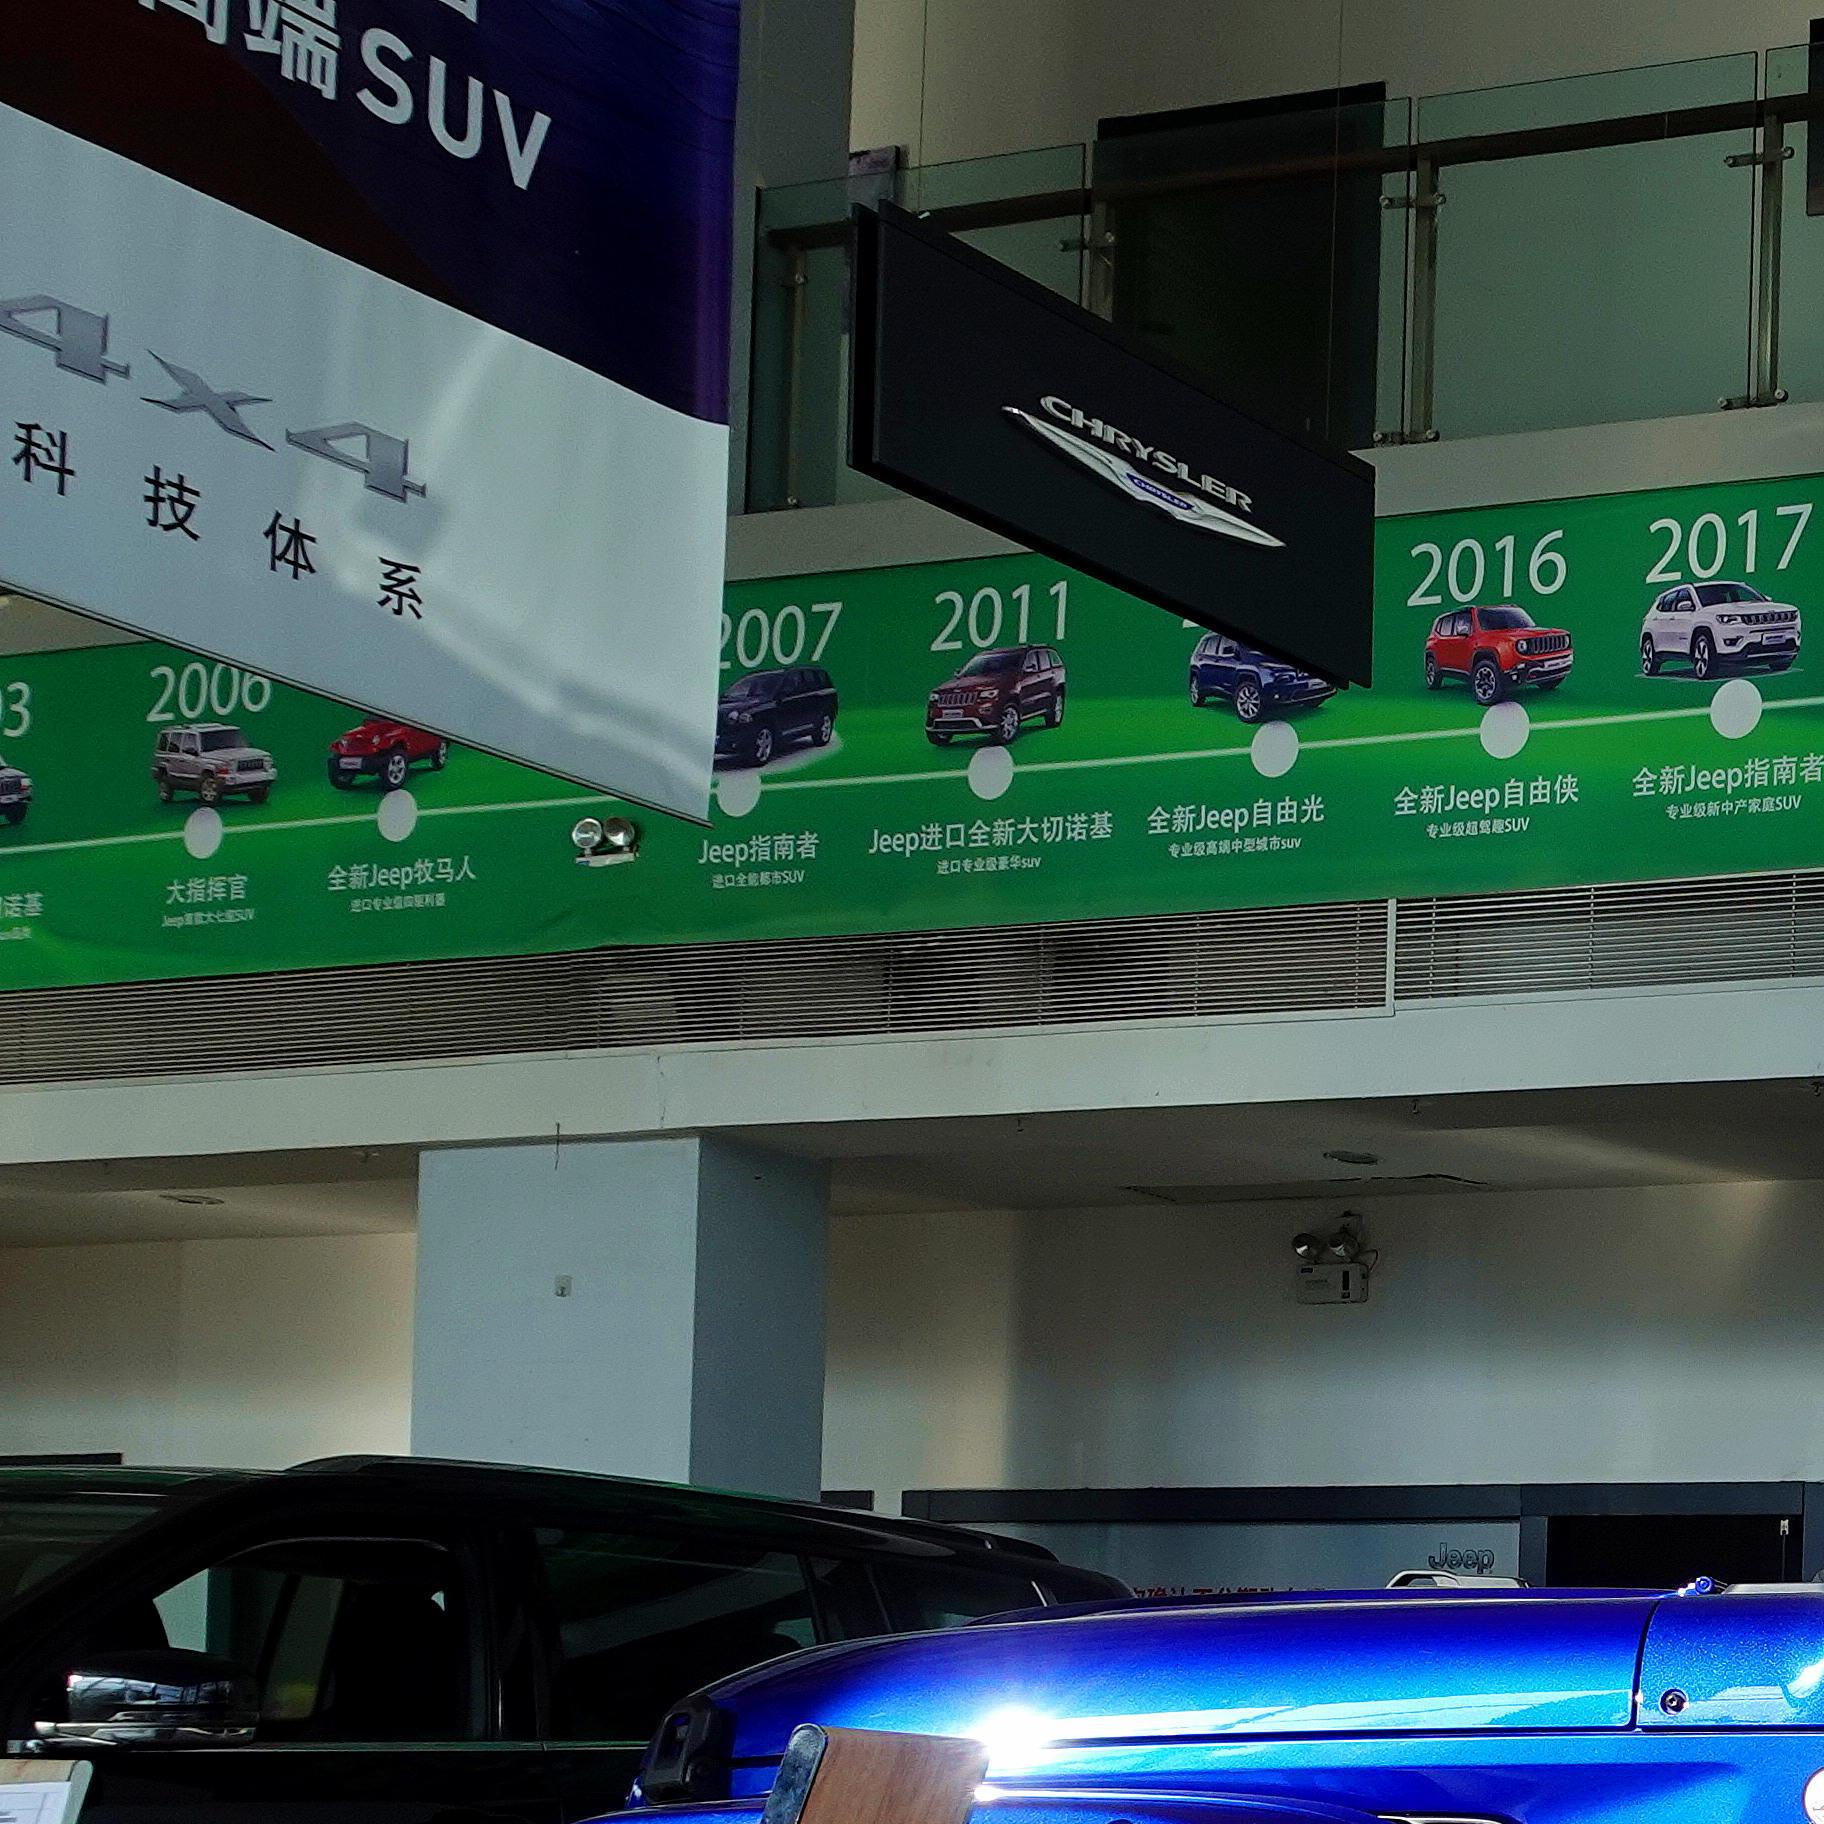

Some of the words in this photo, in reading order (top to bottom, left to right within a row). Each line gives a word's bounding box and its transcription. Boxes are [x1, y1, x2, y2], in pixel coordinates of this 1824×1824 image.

[1040, 395, 1254, 513] CHRYSLER
[12, 420, 425, 620] 科技体系
[1645, 502, 1813, 585] 2017
[1406, 529, 1567, 607] 2016
[929, 580, 1069, 652] 2011
[1146, 793, 1325, 835] 全新Jeep自由光
[1393, 773, 1580, 817] 全新Jeep自由侠
[1665, 795, 1802, 821] 专业级新中产家庭SUV
[697, 830, 820, 868] Jeep指南者
[868, 810, 1113, 858] Jeep进口全新大切诺基
[165, 872, 250, 905] 大指挥官
[327, 854, 477, 892] 全新Jeep牧马人
[1427, 1542, 1495, 1574] Jeep
